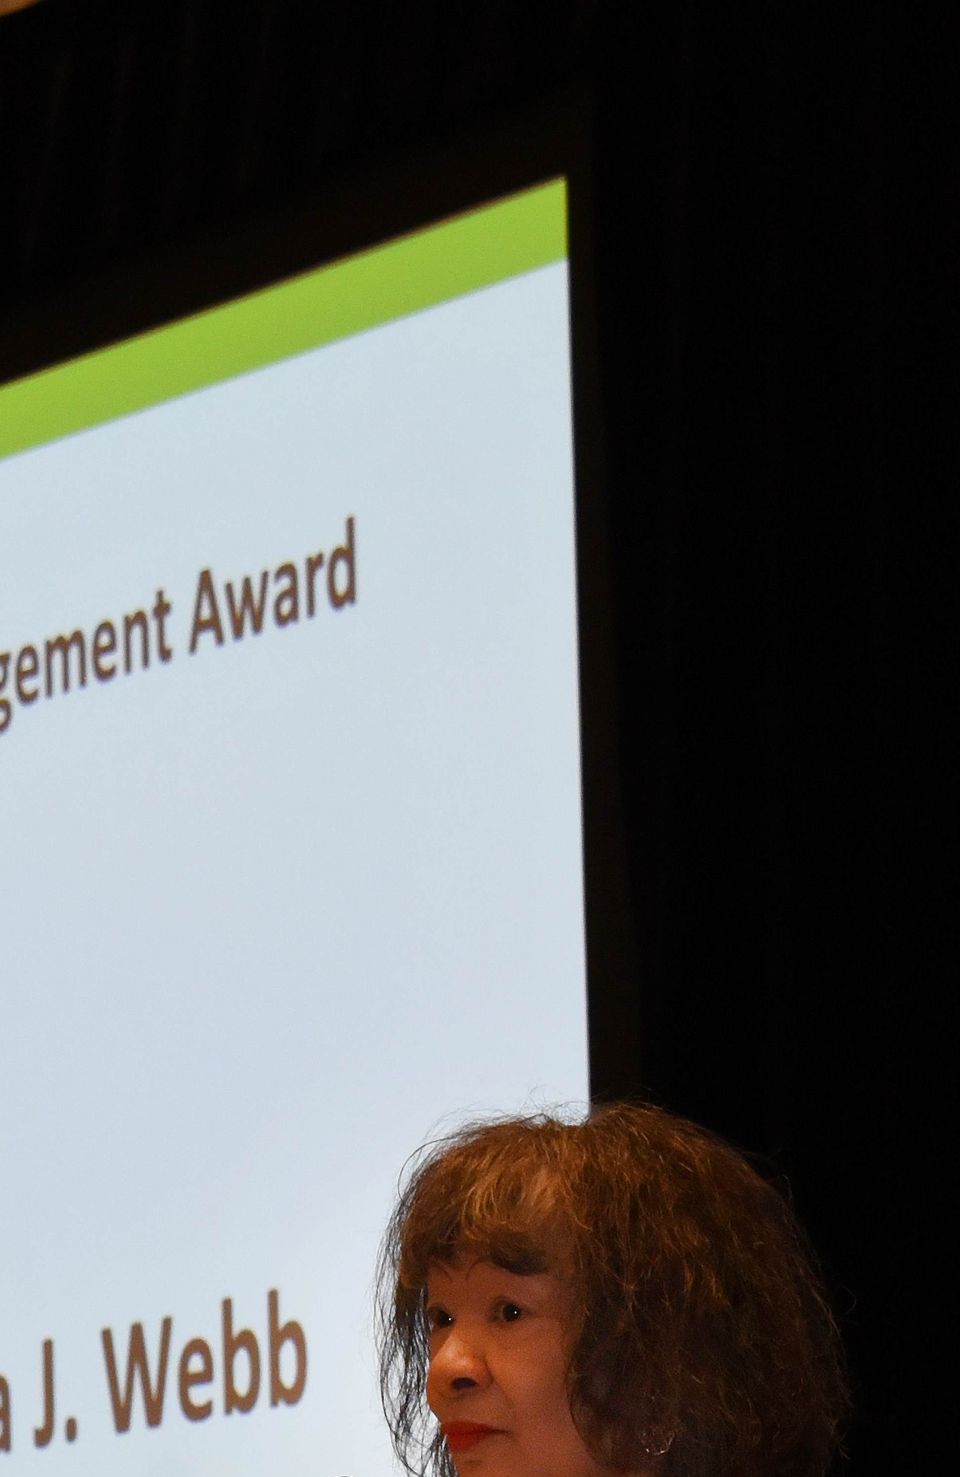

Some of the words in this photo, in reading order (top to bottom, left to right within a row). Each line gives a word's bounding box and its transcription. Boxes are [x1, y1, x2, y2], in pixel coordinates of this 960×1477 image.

[188, 514, 359, 656] Award
[34, 1336, 79, 1449] J.
[100, 1287, 309, 1434] Webb
